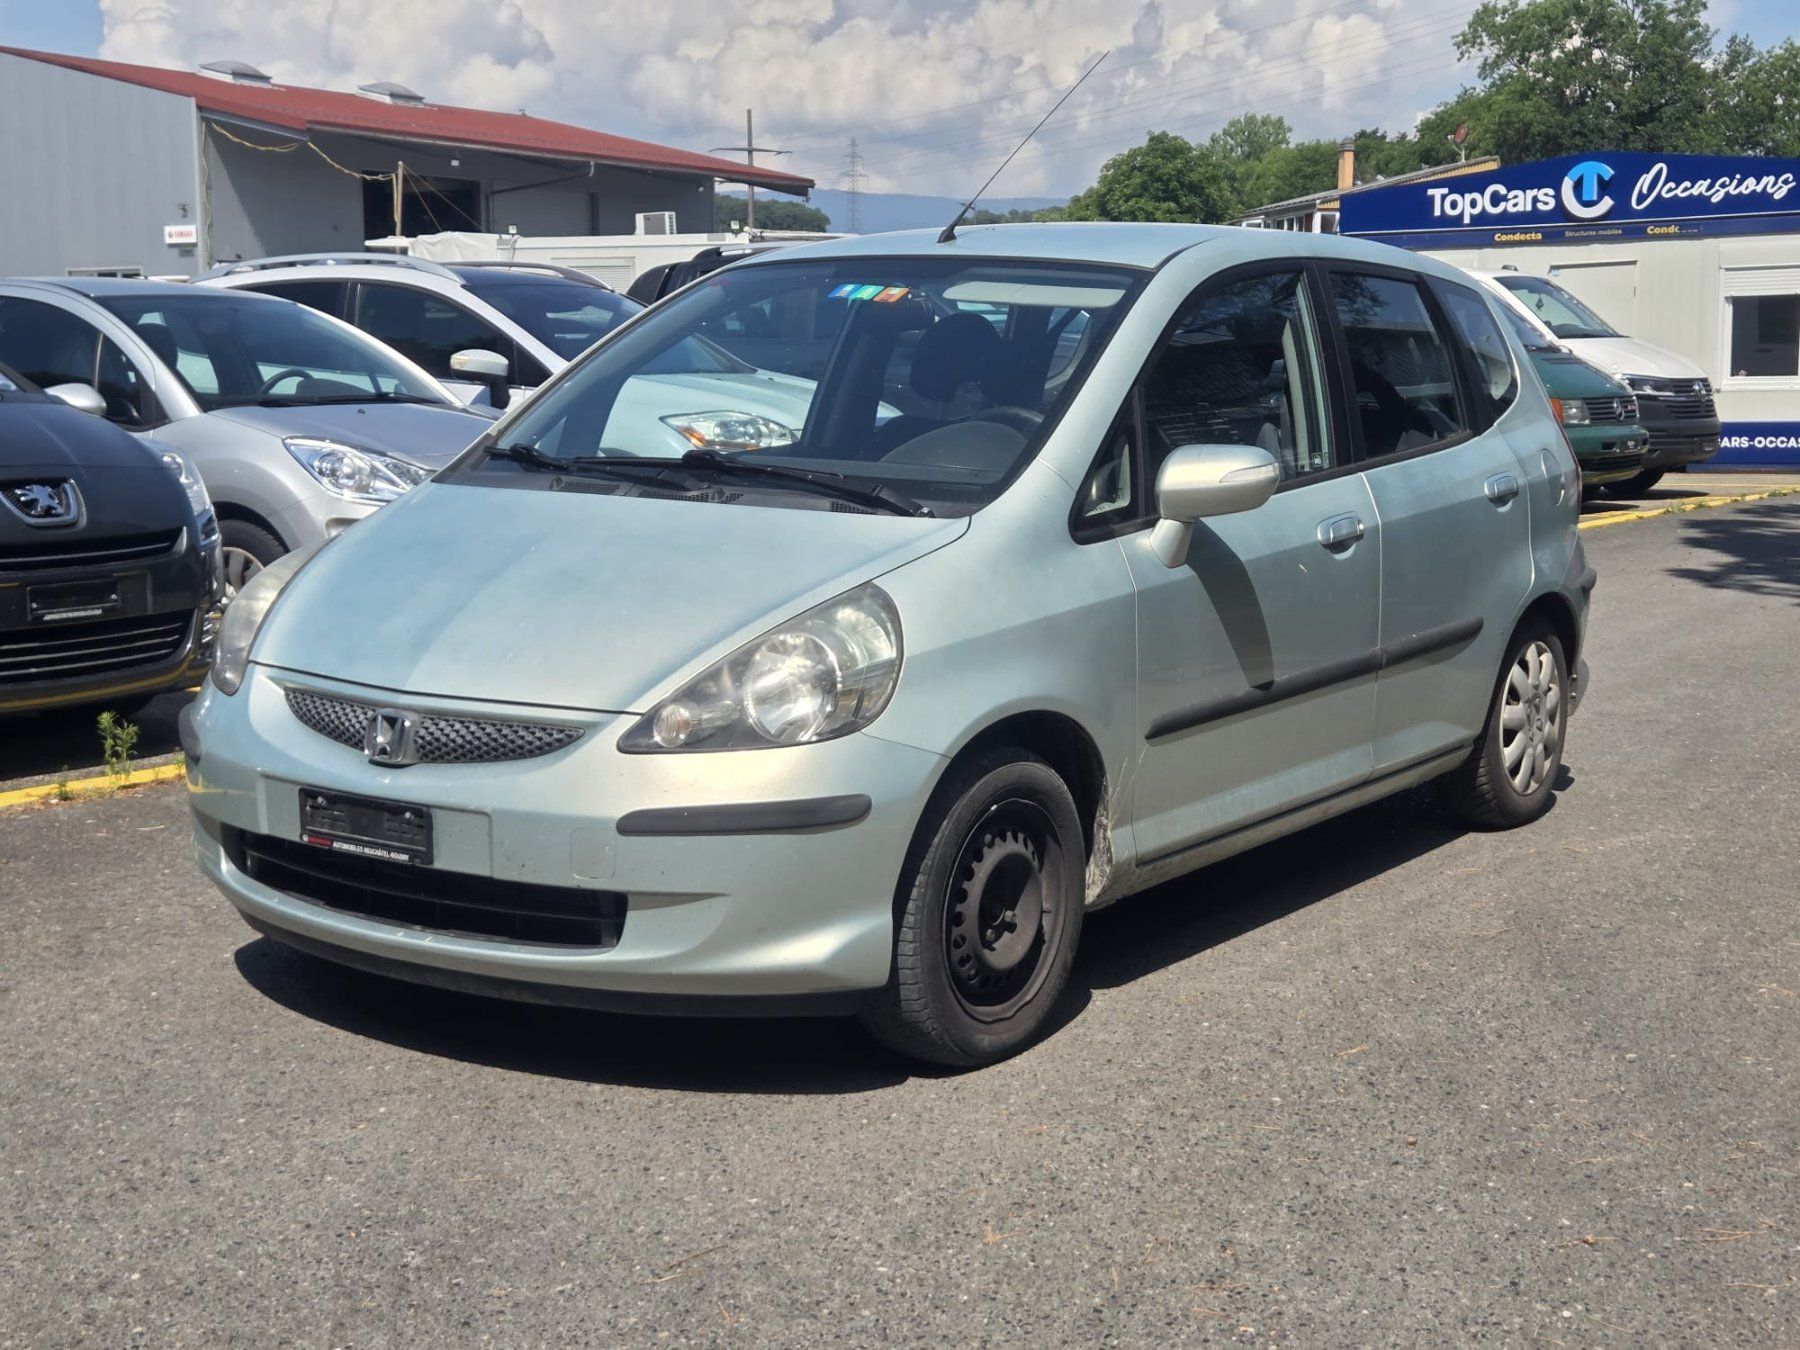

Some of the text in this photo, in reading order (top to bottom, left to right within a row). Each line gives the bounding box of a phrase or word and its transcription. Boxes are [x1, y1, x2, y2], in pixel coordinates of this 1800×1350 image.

[1427, 183, 1556, 224] TopCars
[1631, 162, 1797, 210] Occasions
[1494, 232, 1542, 242] Condecta
